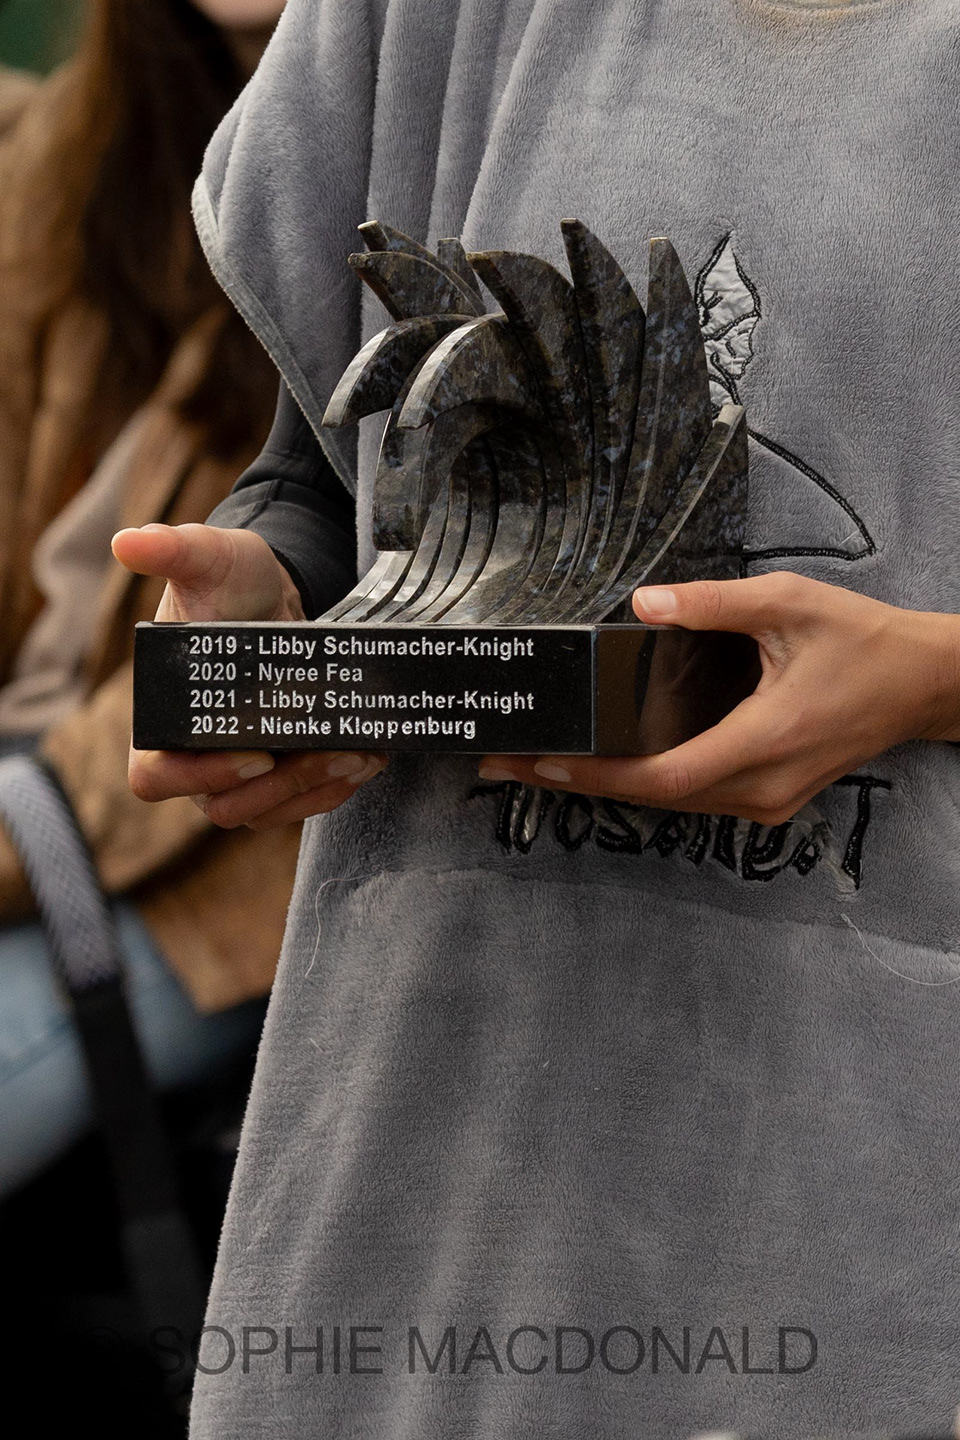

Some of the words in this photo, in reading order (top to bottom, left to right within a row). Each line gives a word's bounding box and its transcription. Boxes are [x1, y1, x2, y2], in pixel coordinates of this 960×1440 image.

[189, 635, 238, 655] 2019
[258, 635, 317, 660] Libby
[323, 635, 534, 661] Schumacher-Knight
[188, 662, 237, 682] 2020
[258, 662, 319, 685] Nyree
[326, 662, 363, 682] Fea
[189, 689, 237, 709] 2021
[259, 689, 317, 714] Libby
[323, 689, 535, 715] Schumacher-Knight
[191, 715, 239, 735] 2022
[260, 715, 332, 736] Nienke
[339, 715, 476, 740] Kloppenburg
